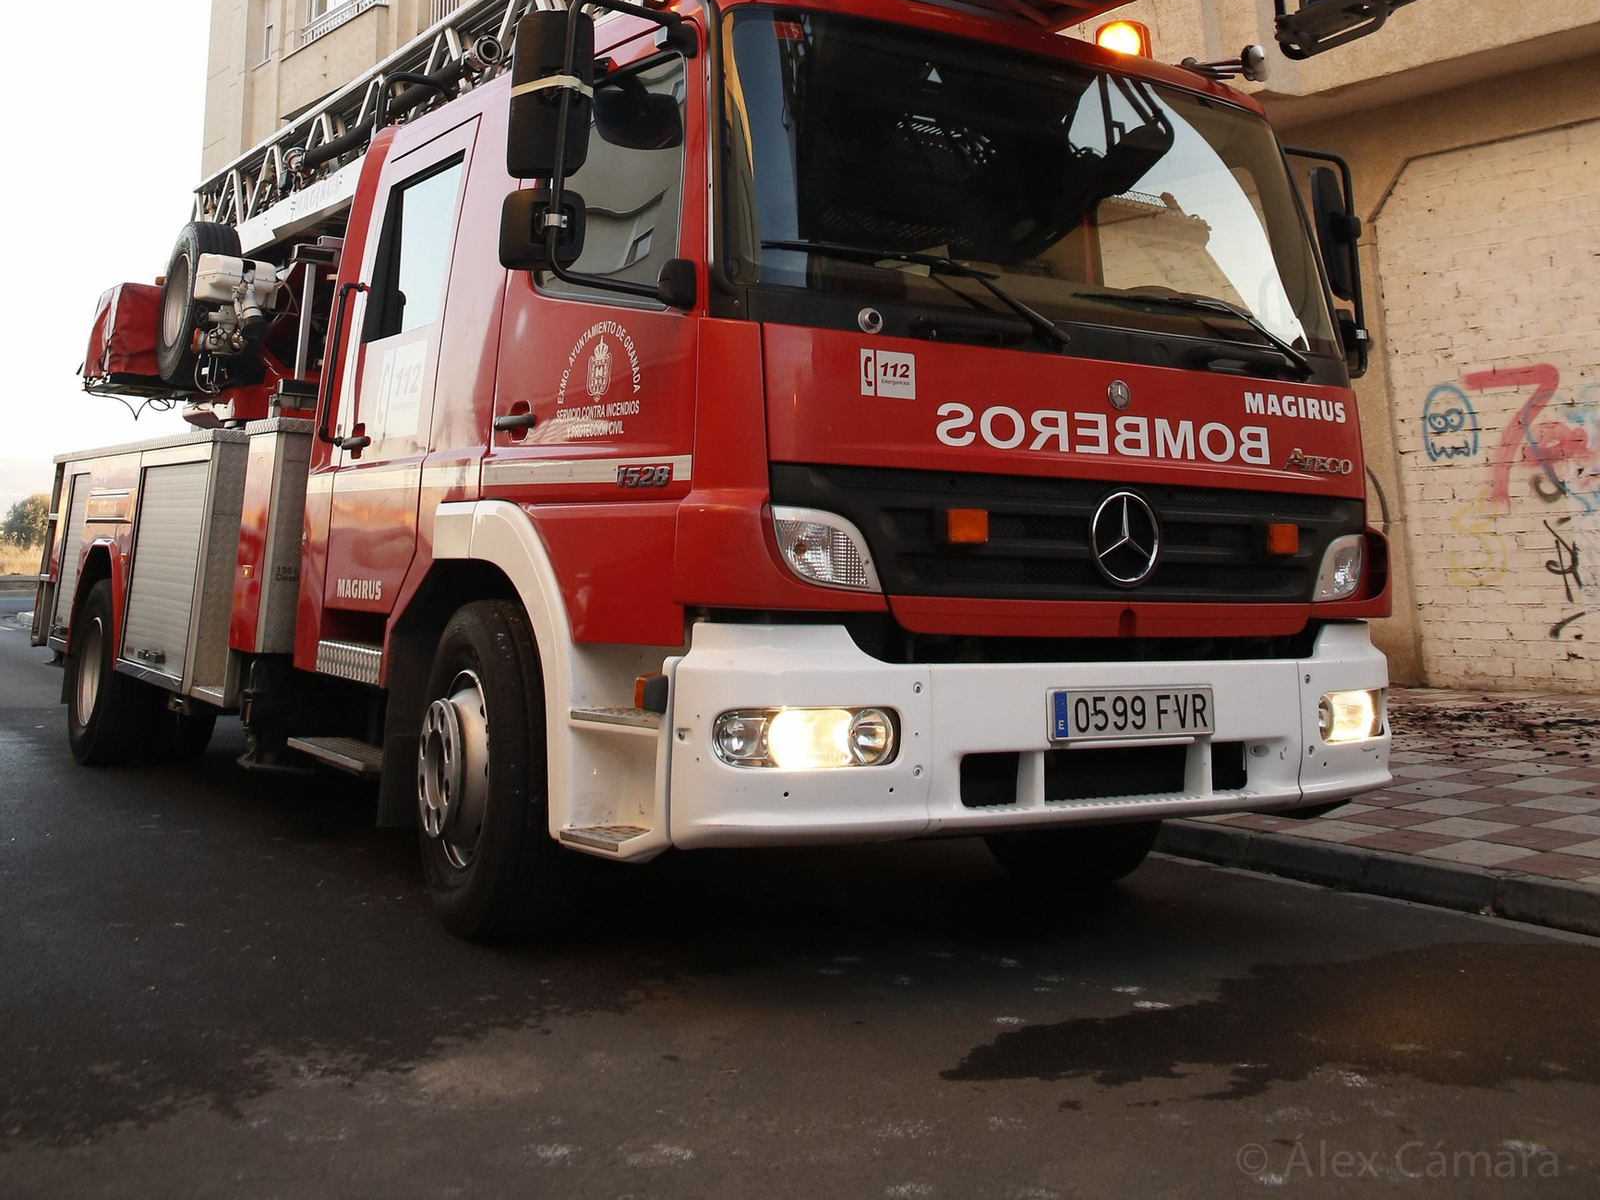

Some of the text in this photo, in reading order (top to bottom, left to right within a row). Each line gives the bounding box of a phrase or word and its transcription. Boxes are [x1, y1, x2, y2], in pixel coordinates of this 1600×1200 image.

[557, 320, 641, 404] EXMO. AYUNTAMIENTO DE GRANADA
[880, 362, 910, 378] 112
[395, 362, 422, 397] 112
[556, 399, 640, 422] SERVICIO CONTRA INCENDIOS
[1243, 391, 1347, 424] MAGIRUS
[608, 420, 625, 435] CIVIL
[617, 465, 671, 488] 1528
[336, 578, 382, 600] MAGIRUS
[1074, 693, 1208, 733] 0599 FVR
[1058, 719, 1065, 731] E
